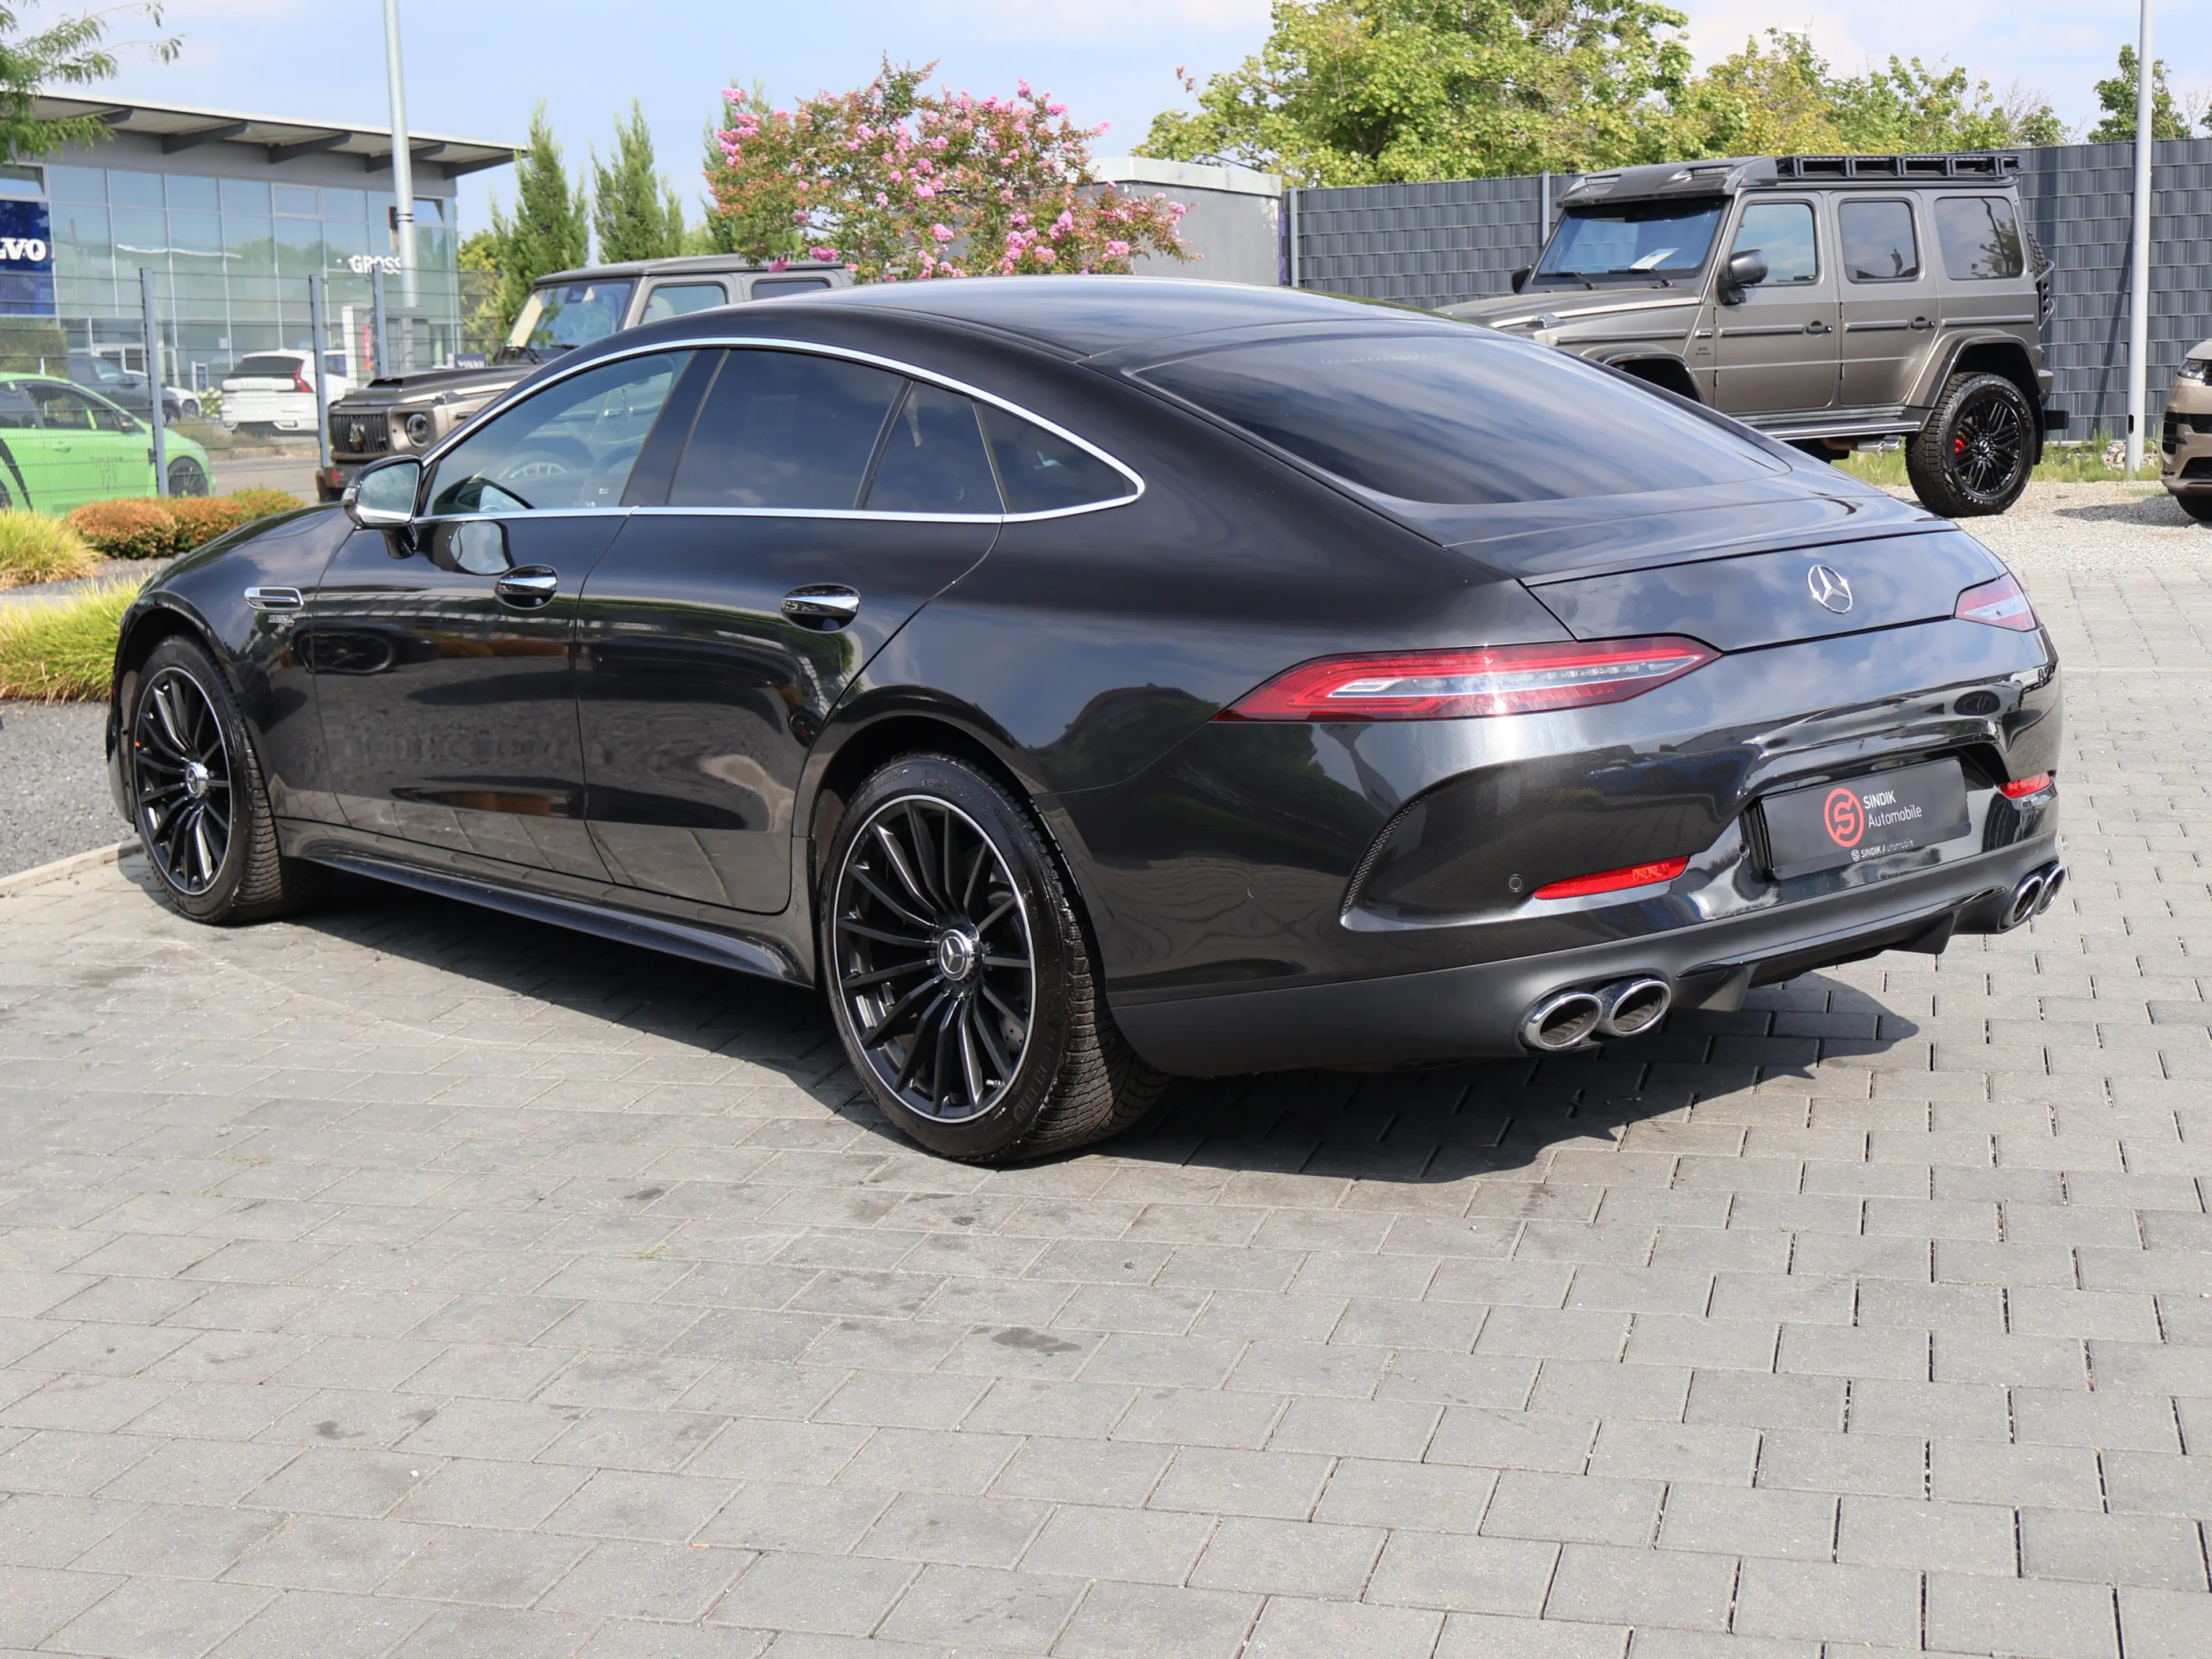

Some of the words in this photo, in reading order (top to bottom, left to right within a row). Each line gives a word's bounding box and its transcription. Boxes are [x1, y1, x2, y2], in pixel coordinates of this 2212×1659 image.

[1863, 790, 1896, 809] SINDIK
[1868, 804, 1923, 828] Automobile
[1861, 847, 1882, 858] SINDIK
